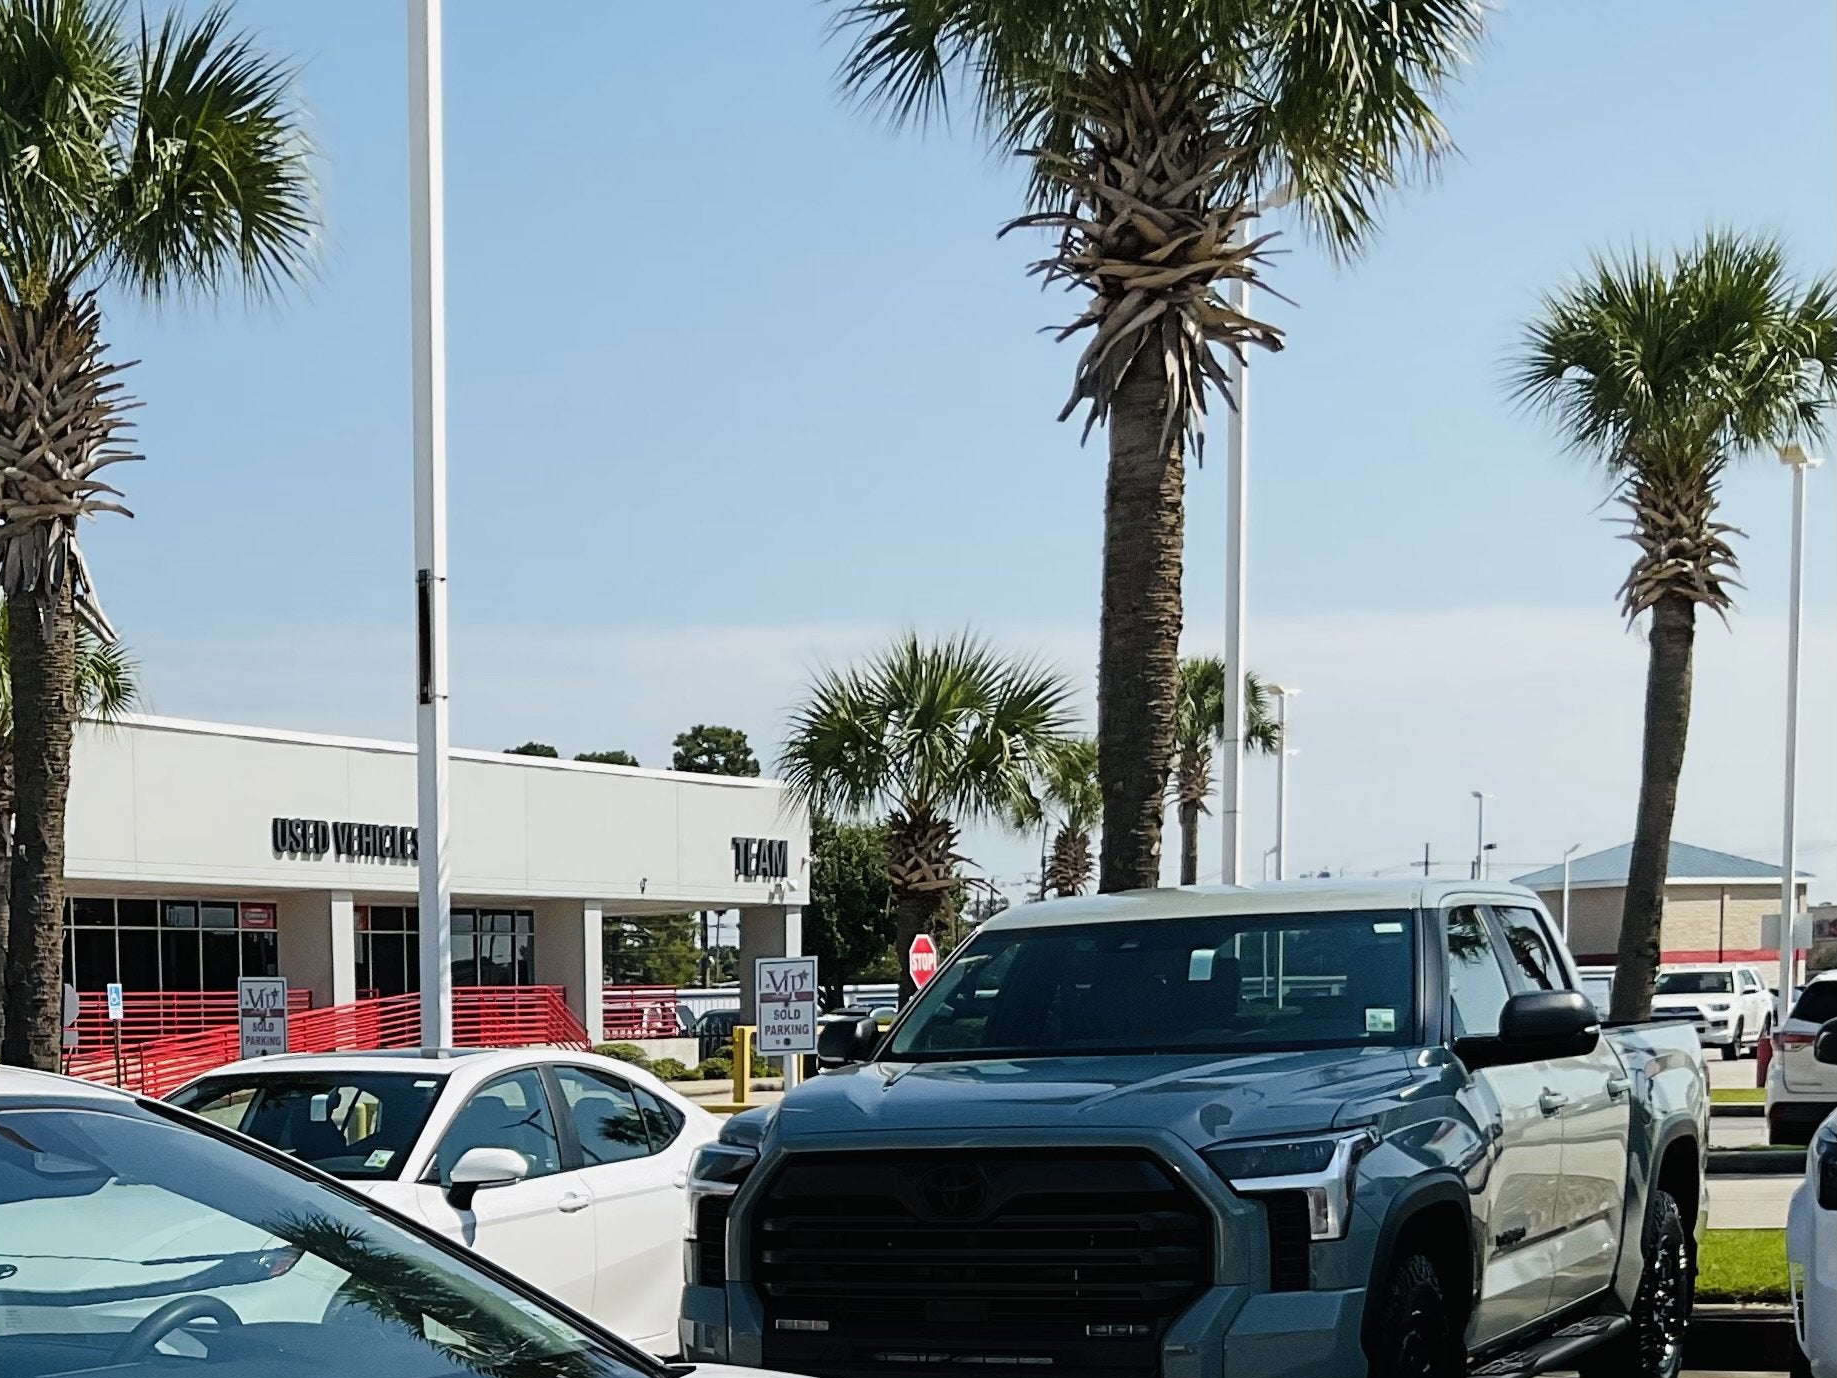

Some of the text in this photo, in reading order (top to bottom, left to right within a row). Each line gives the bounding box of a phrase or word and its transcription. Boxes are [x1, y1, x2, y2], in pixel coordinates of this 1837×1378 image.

[272, 818, 330, 855] USED
[731, 837, 788, 877] TEAM
[912, 952, 934, 971] STOP
[773, 1009, 801, 1021] SOLD
[252, 1021, 275, 1033] SOLD
[764, 1024, 810, 1037] PARKING
[245, 1035, 282, 1047] PARKING
